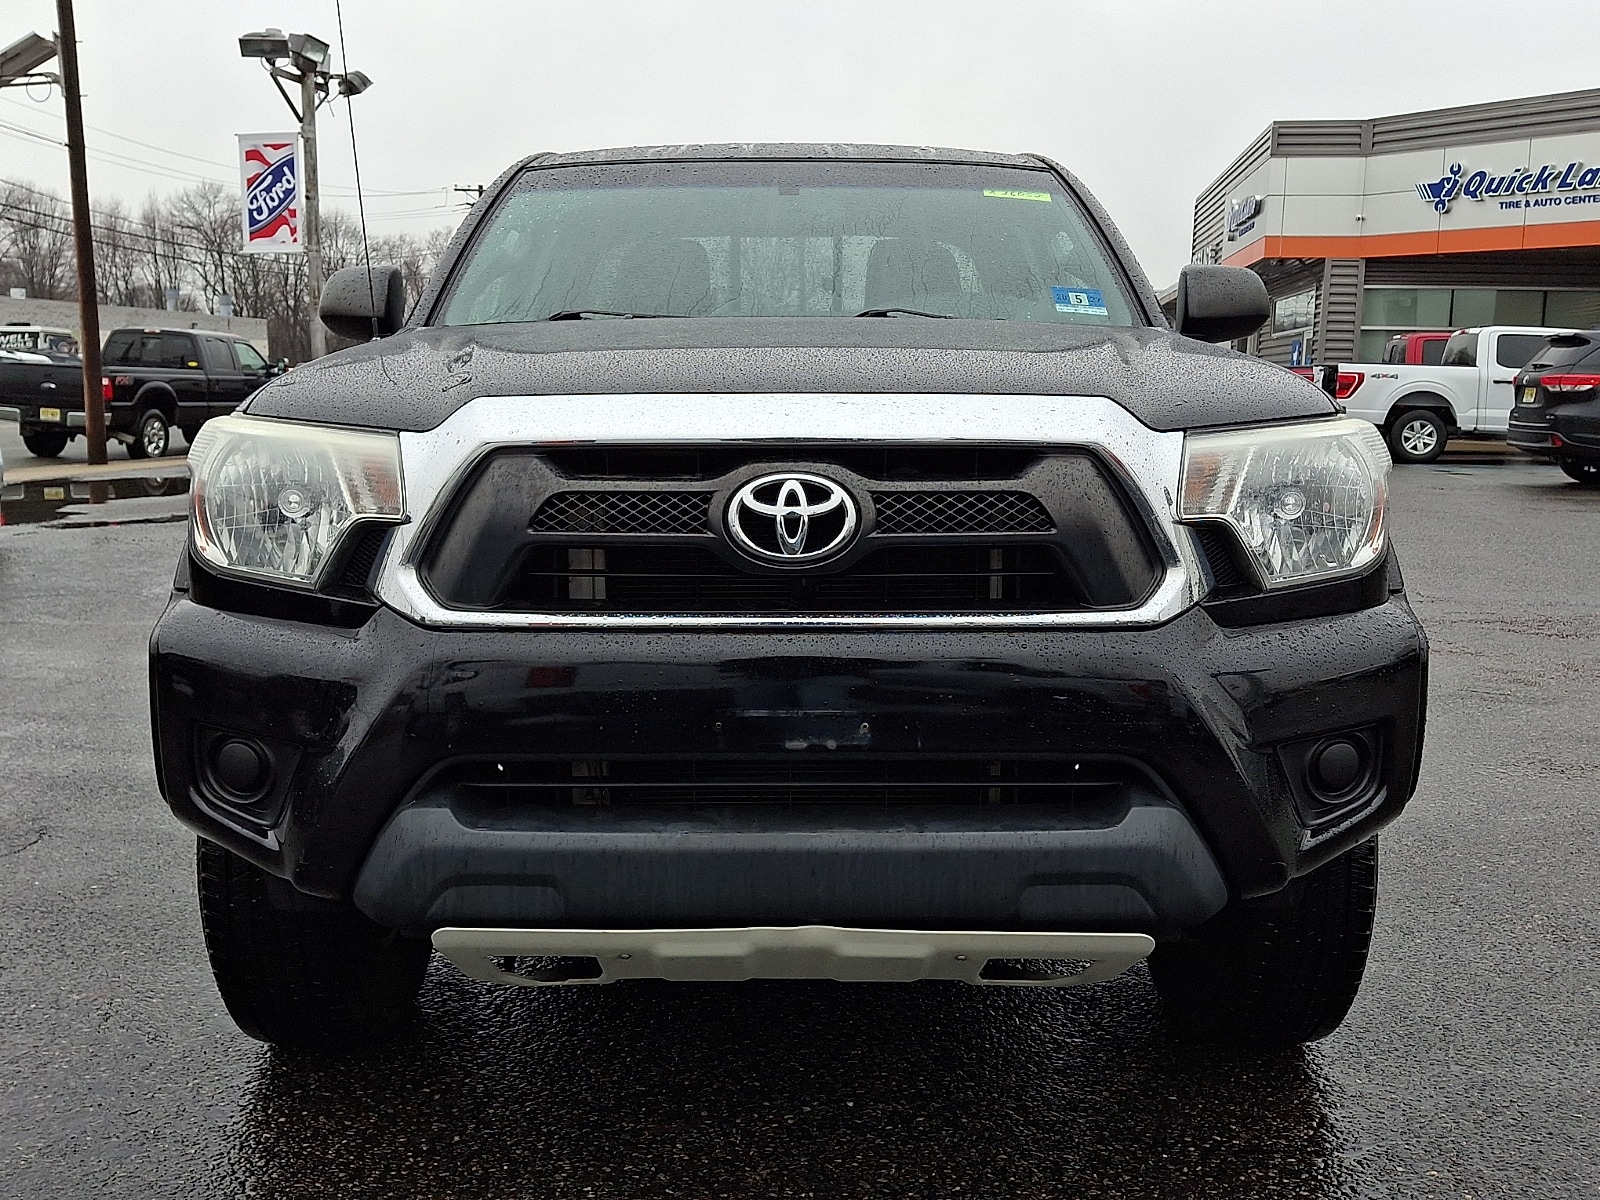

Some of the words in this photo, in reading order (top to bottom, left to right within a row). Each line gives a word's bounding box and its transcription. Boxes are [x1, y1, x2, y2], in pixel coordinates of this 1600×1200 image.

[247, 165, 296, 221] Ford
[1462, 164, 1556, 200] Quick
[1556, 161, 1600, 191] La
[1499, 201, 1522, 210] TIRE
[1533, 197, 1562, 207] AUTO
[1074, 294, 1083, 304] 5
